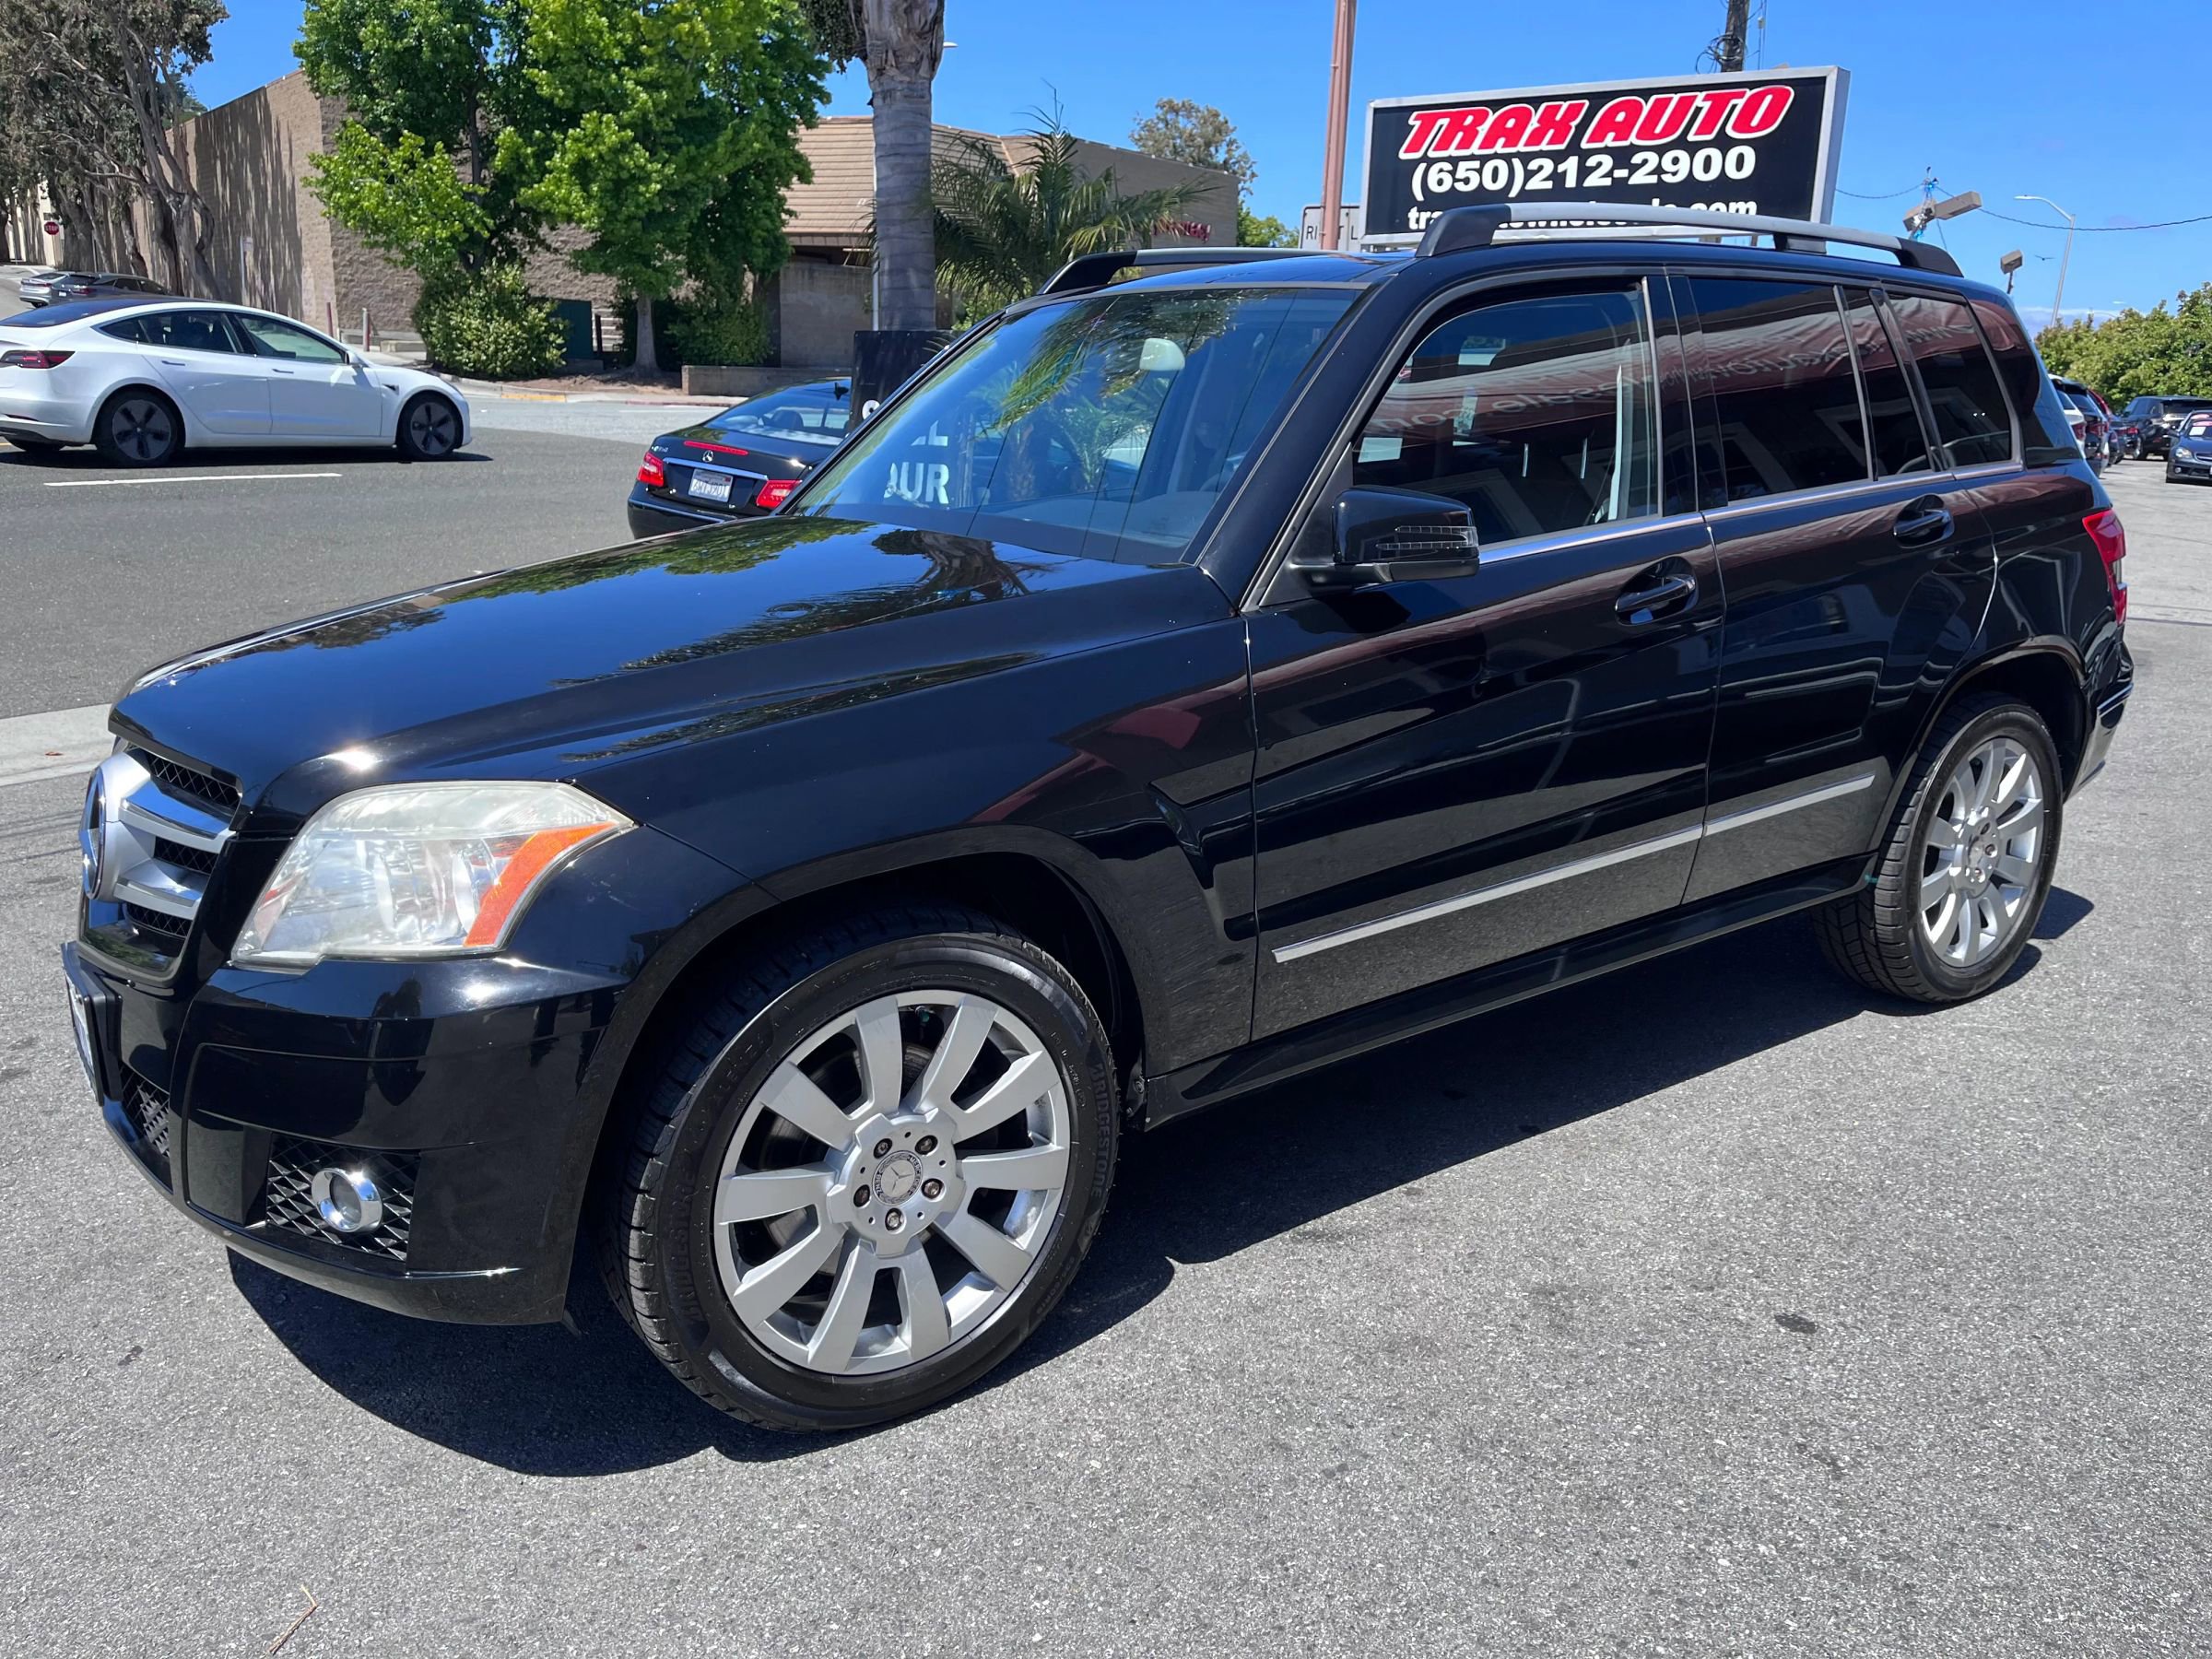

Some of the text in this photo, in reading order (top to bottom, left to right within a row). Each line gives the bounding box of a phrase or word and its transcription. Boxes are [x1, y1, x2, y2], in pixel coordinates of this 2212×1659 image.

[1398, 85, 1794, 159] TRAX AUTO
[1411, 146, 1756, 201] (650)212-2900
